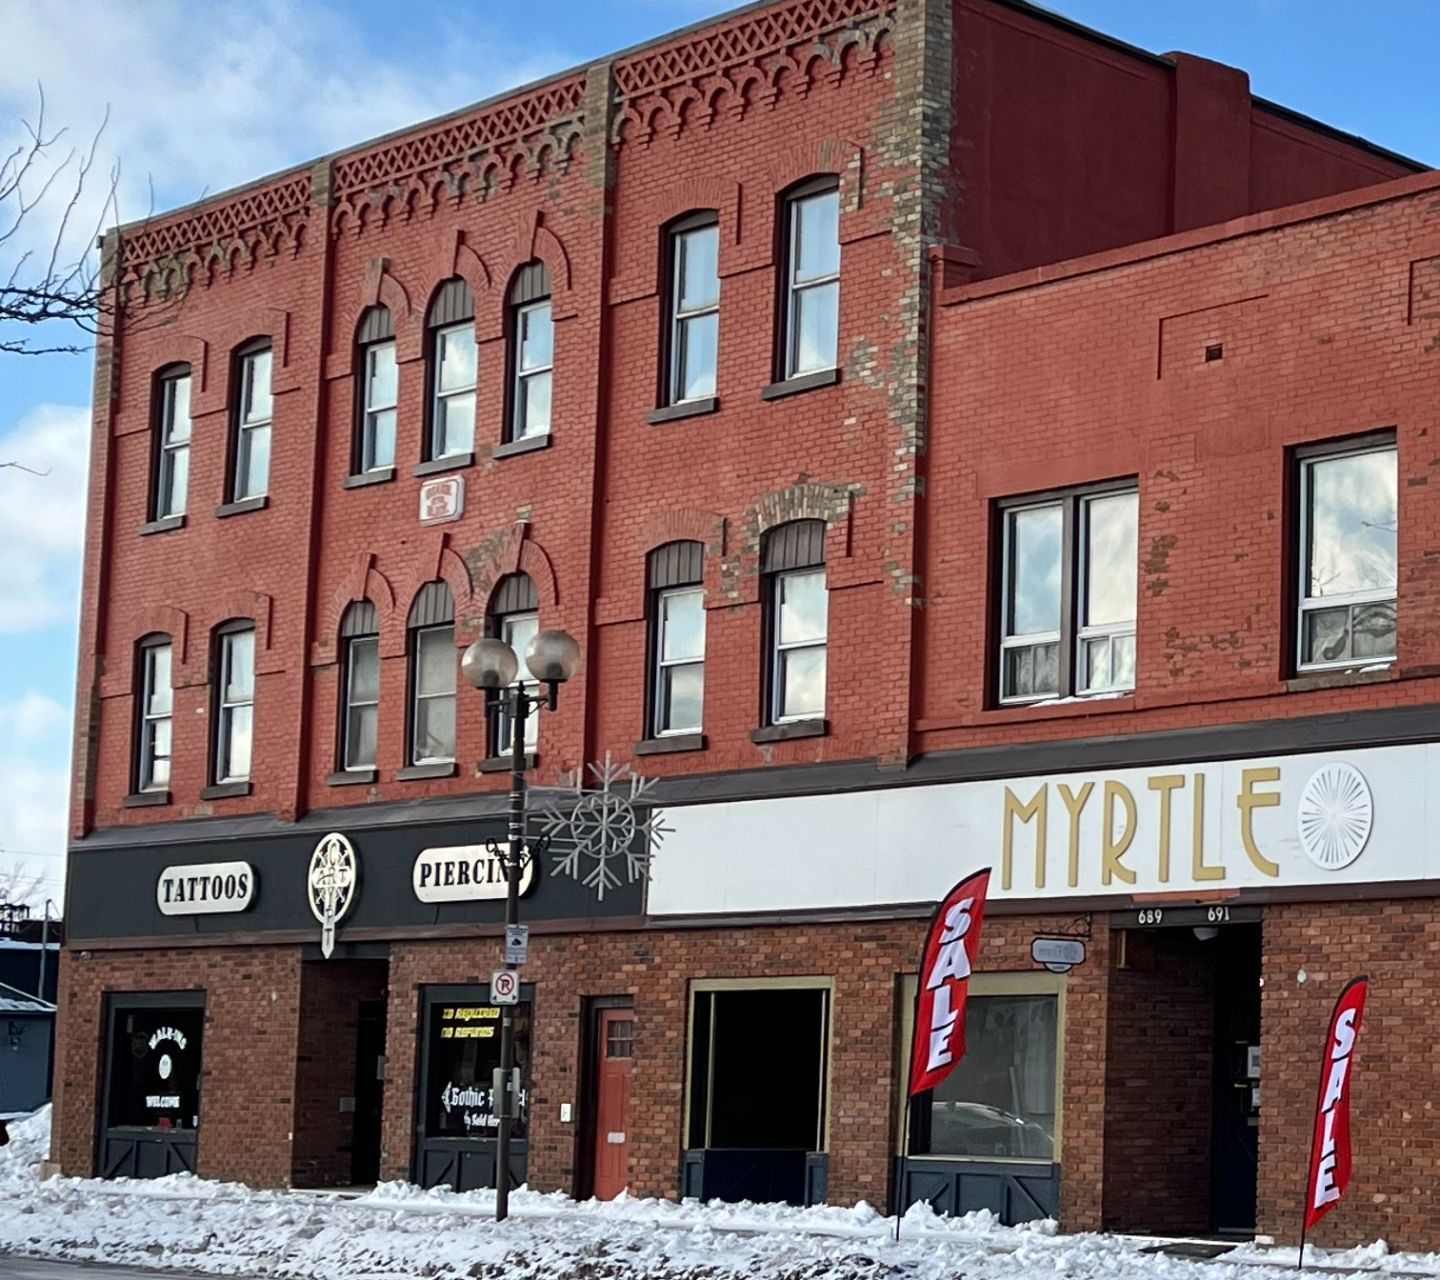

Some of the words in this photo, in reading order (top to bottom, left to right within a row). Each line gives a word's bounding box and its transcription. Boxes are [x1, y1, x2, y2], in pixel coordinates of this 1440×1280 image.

[1001, 766, 1281, 891] MYRTLE
[162, 873, 248, 903] TATTOOS
[419, 857, 510, 888] PIERCIN
[1138, 909, 1162, 924] 689
[1207, 906, 1231, 921] 691
[926, 897, 975, 1073] SALE
[1313, 1007, 1358, 1209] SALE
